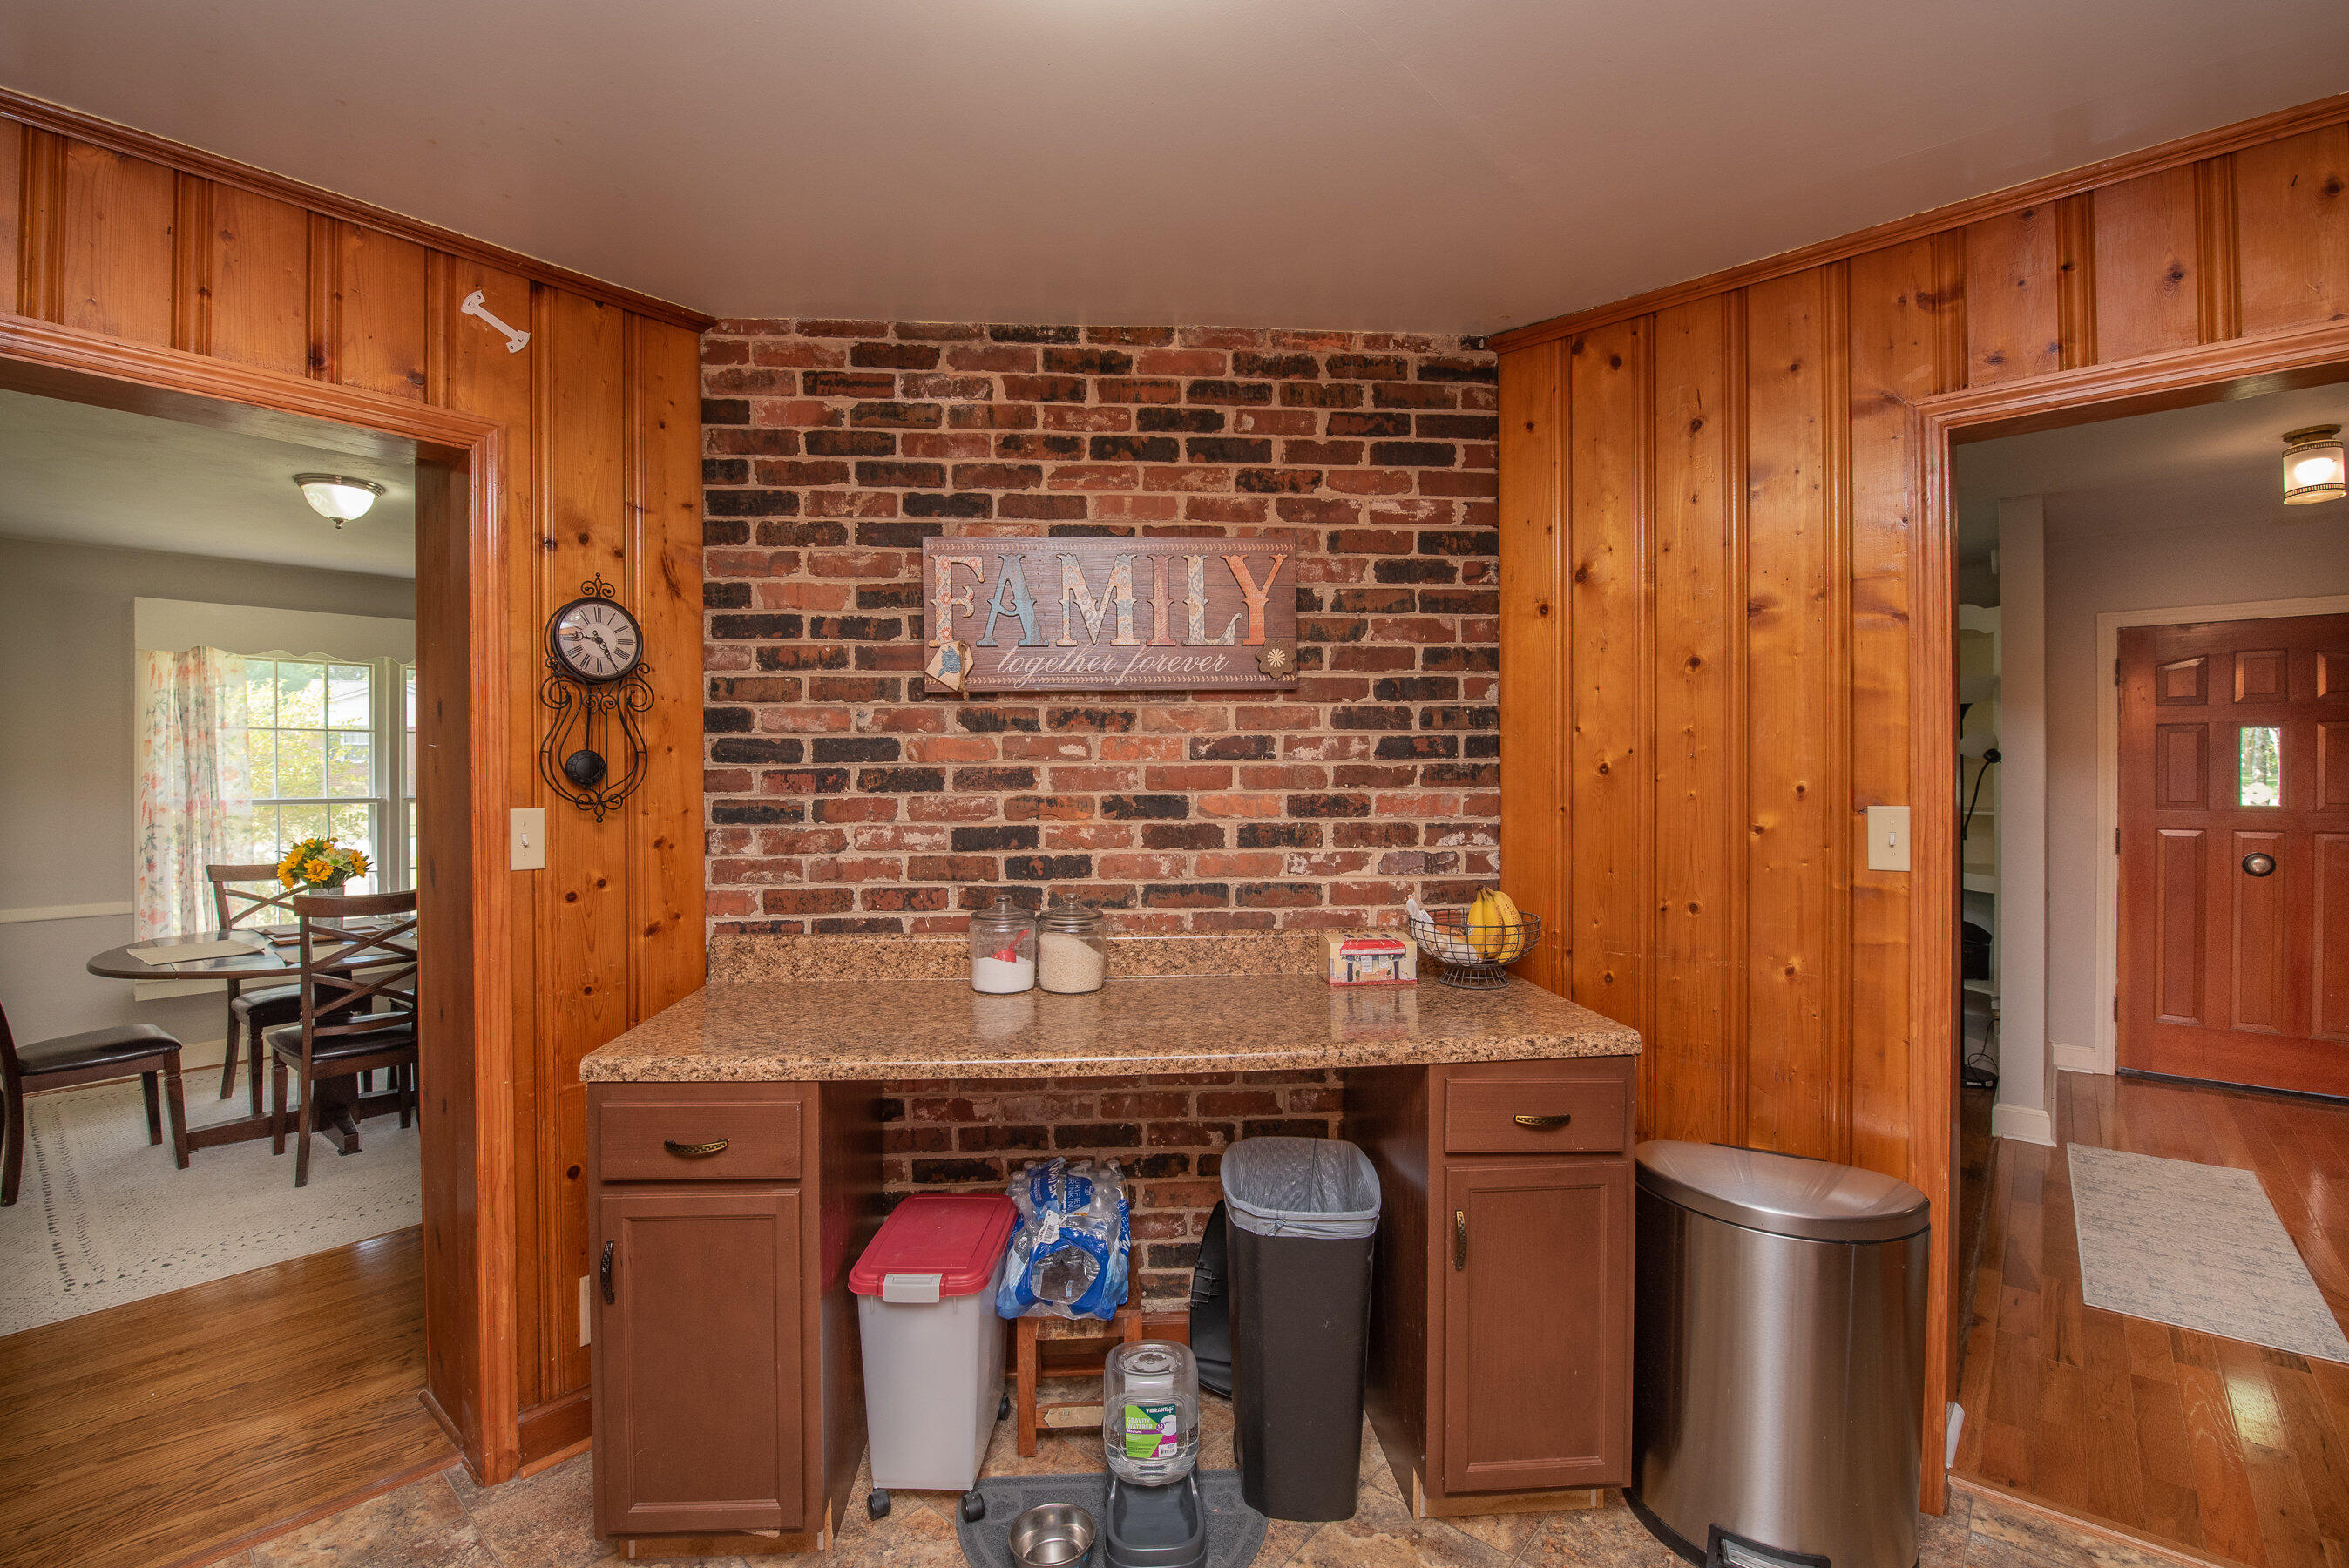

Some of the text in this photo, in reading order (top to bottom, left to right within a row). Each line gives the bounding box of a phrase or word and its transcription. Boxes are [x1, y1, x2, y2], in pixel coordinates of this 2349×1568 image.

[928, 553, 1289, 647] FAMILY
[997, 639, 1229, 689] together forever
